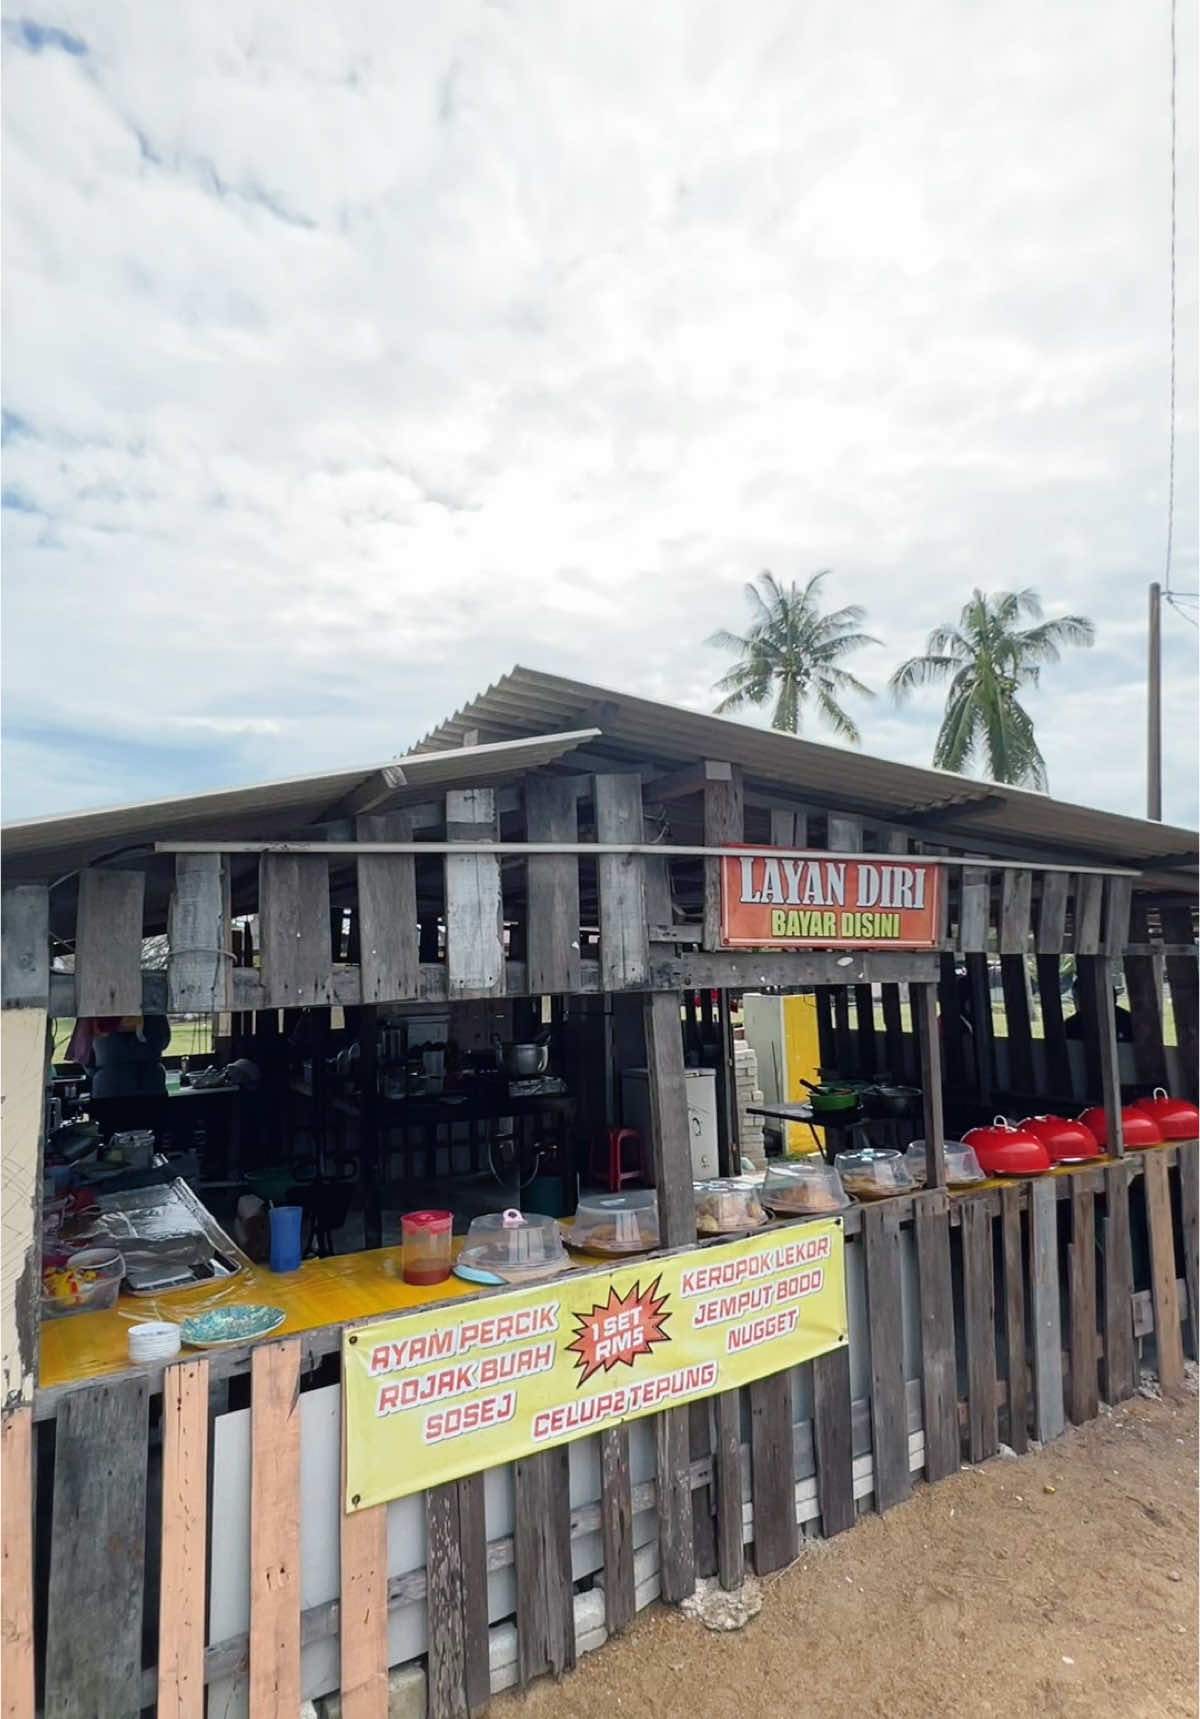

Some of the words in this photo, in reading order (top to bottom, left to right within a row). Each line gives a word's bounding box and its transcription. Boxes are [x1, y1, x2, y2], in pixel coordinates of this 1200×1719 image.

[739, 856, 847, 906] LAYAN
[856, 864, 927, 909] DIRI
[771, 909, 836, 937] BAYAR
[841, 912, 900, 938] DISINI
[681, 1253, 772, 1294] KEROPOK
[775, 1236, 829, 1269] LEKOR
[591, 1323, 600, 1342] 1
[603, 1306, 643, 1337] SET
[693, 1285, 773, 1326] JEMPUT
[776, 1269, 822, 1301] BODO
[370, 1328, 454, 1372] AYAM
[458, 1306, 555, 1350] PERCIK
[594, 1326, 645, 1362] RM5
[727, 1309, 798, 1350] NUGGET
[377, 1364, 475, 1412] ROJAK
[479, 1344, 551, 1384] BUAH
[532, 1390, 626, 1438] CELUP2
[630, 1363, 715, 1407] TEPUNG
[424, 1393, 512, 1440] SOSEJ
